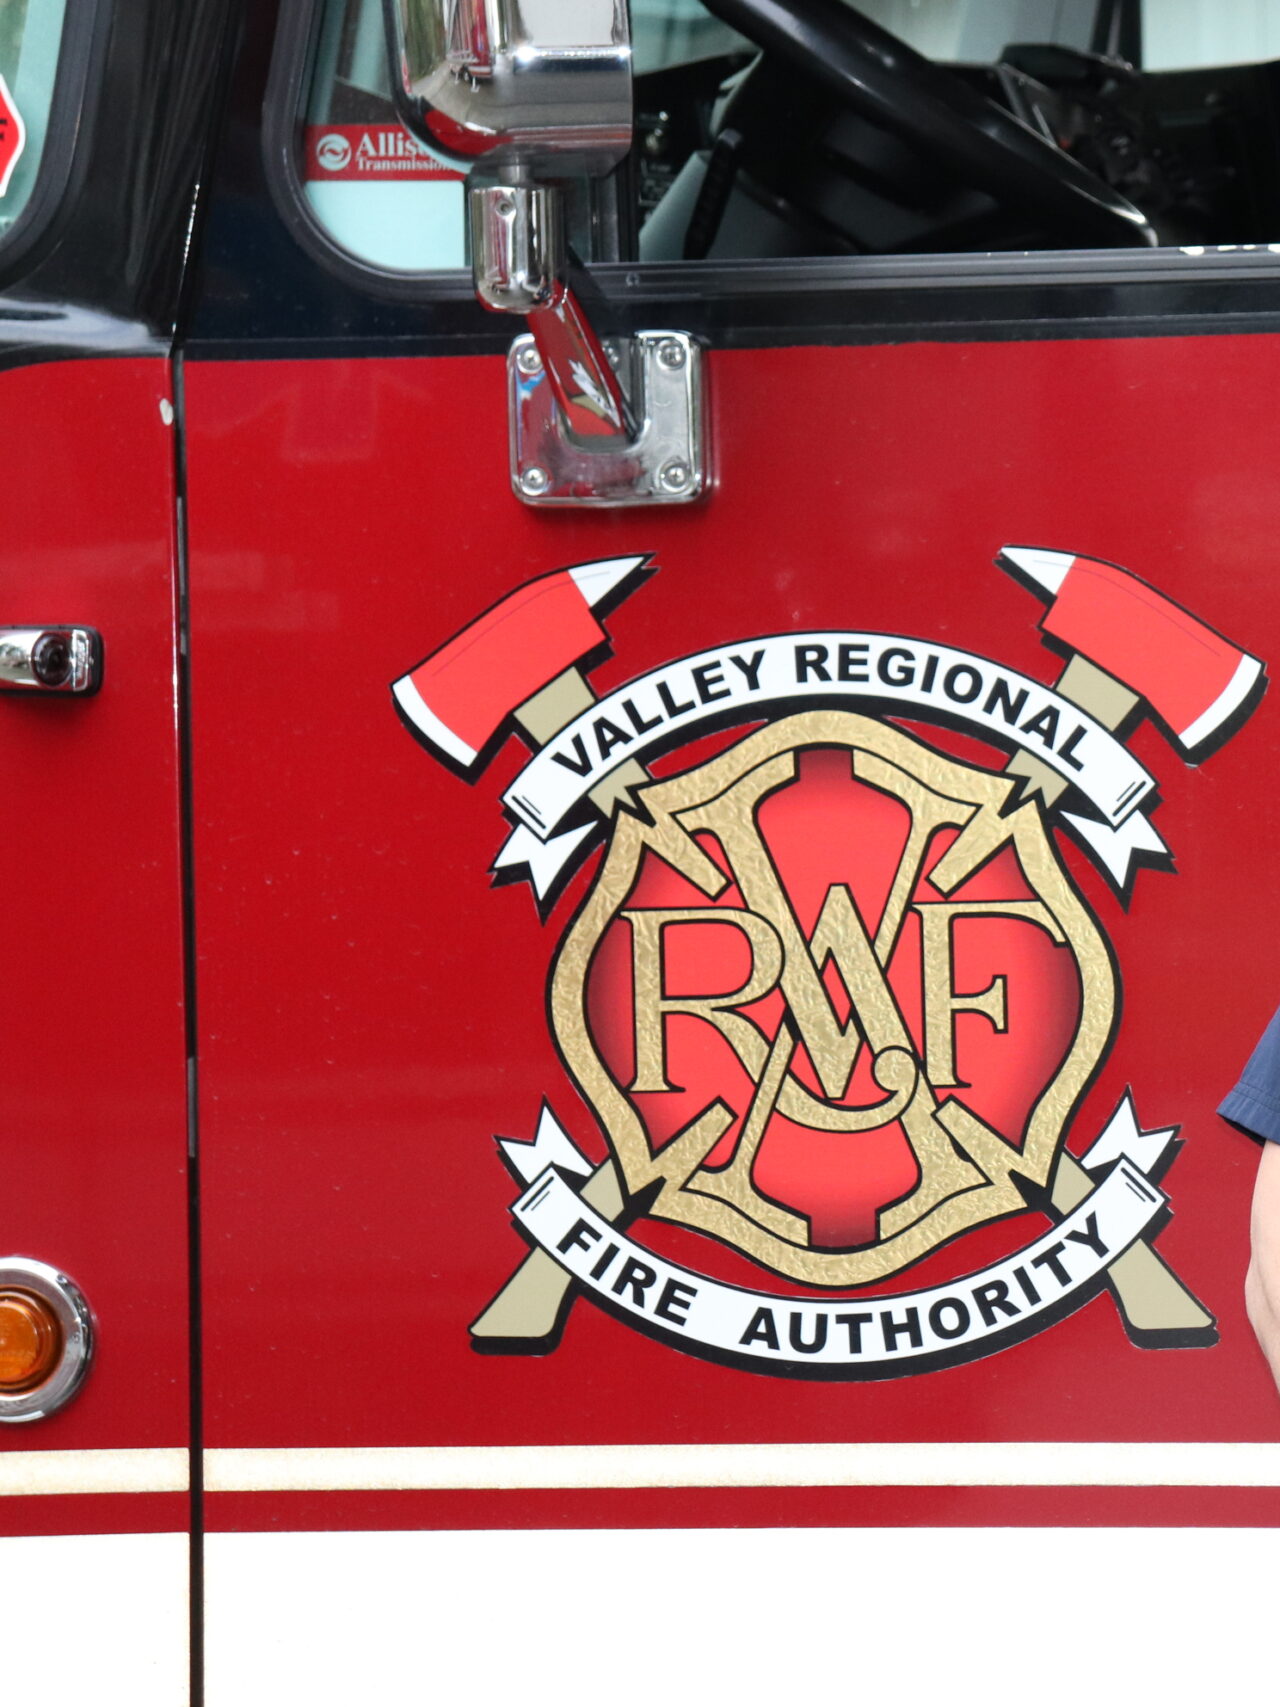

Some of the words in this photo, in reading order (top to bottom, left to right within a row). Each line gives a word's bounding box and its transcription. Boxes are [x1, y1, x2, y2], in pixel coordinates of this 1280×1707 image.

[356, 132, 429, 156] Allis
[550, 648, 766, 778] VALLEY
[794, 643, 1088, 772] REGIONAL
[555, 1217, 699, 1327] FIRE
[739, 1210, 1110, 1354] AUTHORITY
